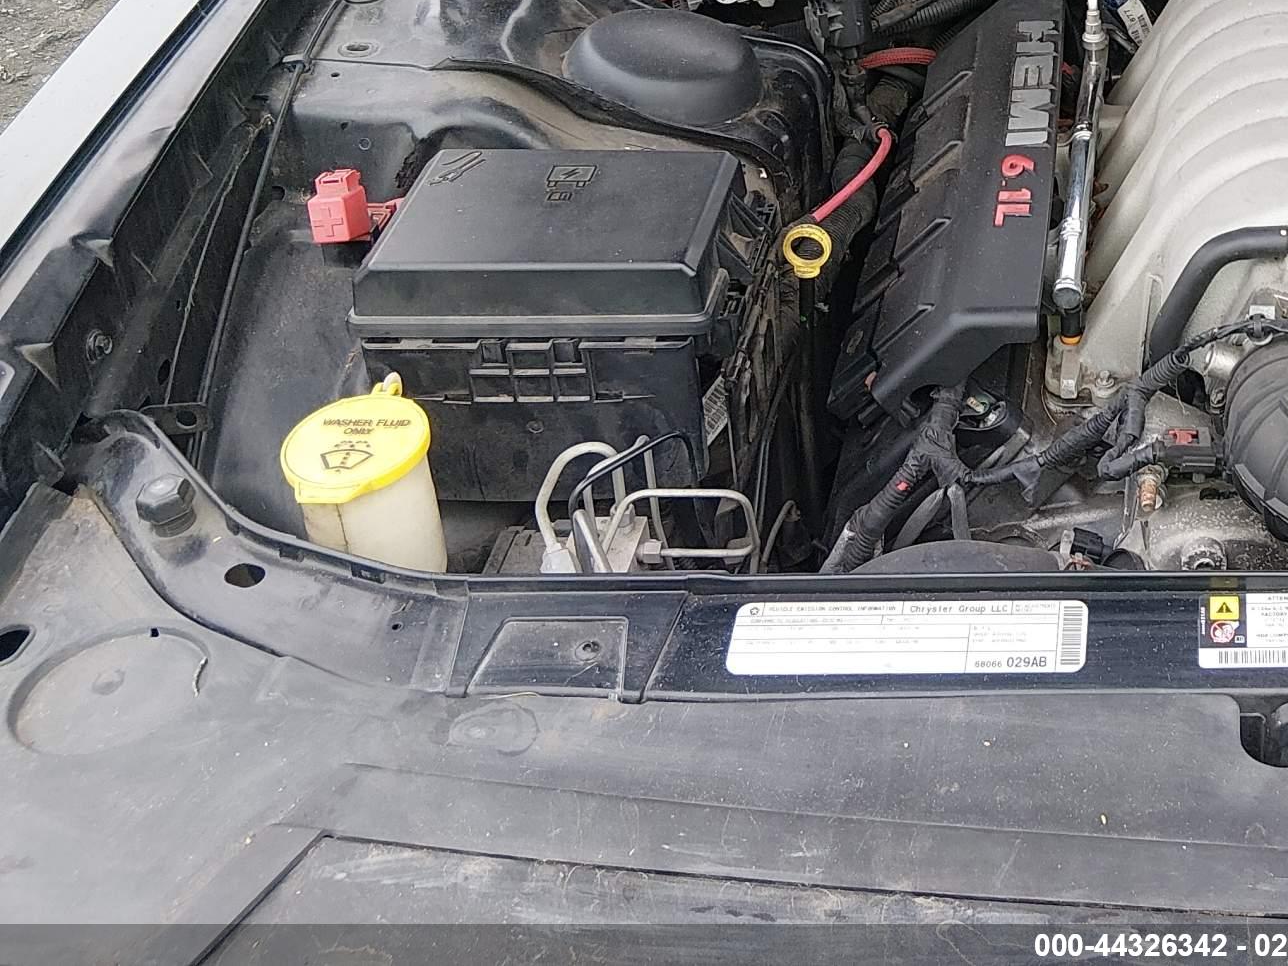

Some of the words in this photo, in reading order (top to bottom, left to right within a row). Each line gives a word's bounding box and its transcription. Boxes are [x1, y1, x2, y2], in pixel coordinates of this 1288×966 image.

[1005, 20, 1057, 147] HEMI
[993, 154, 1035, 227] 6.1L
[323, 418, 373, 427] WASHER
[376, 418, 412, 427] FLUID
[910, 605, 953, 615] Chrysler
[958, 605, 986, 615] Group
[974, 660, 1002, 668] 68066
[1006, 657, 1047, 668] 029AB
